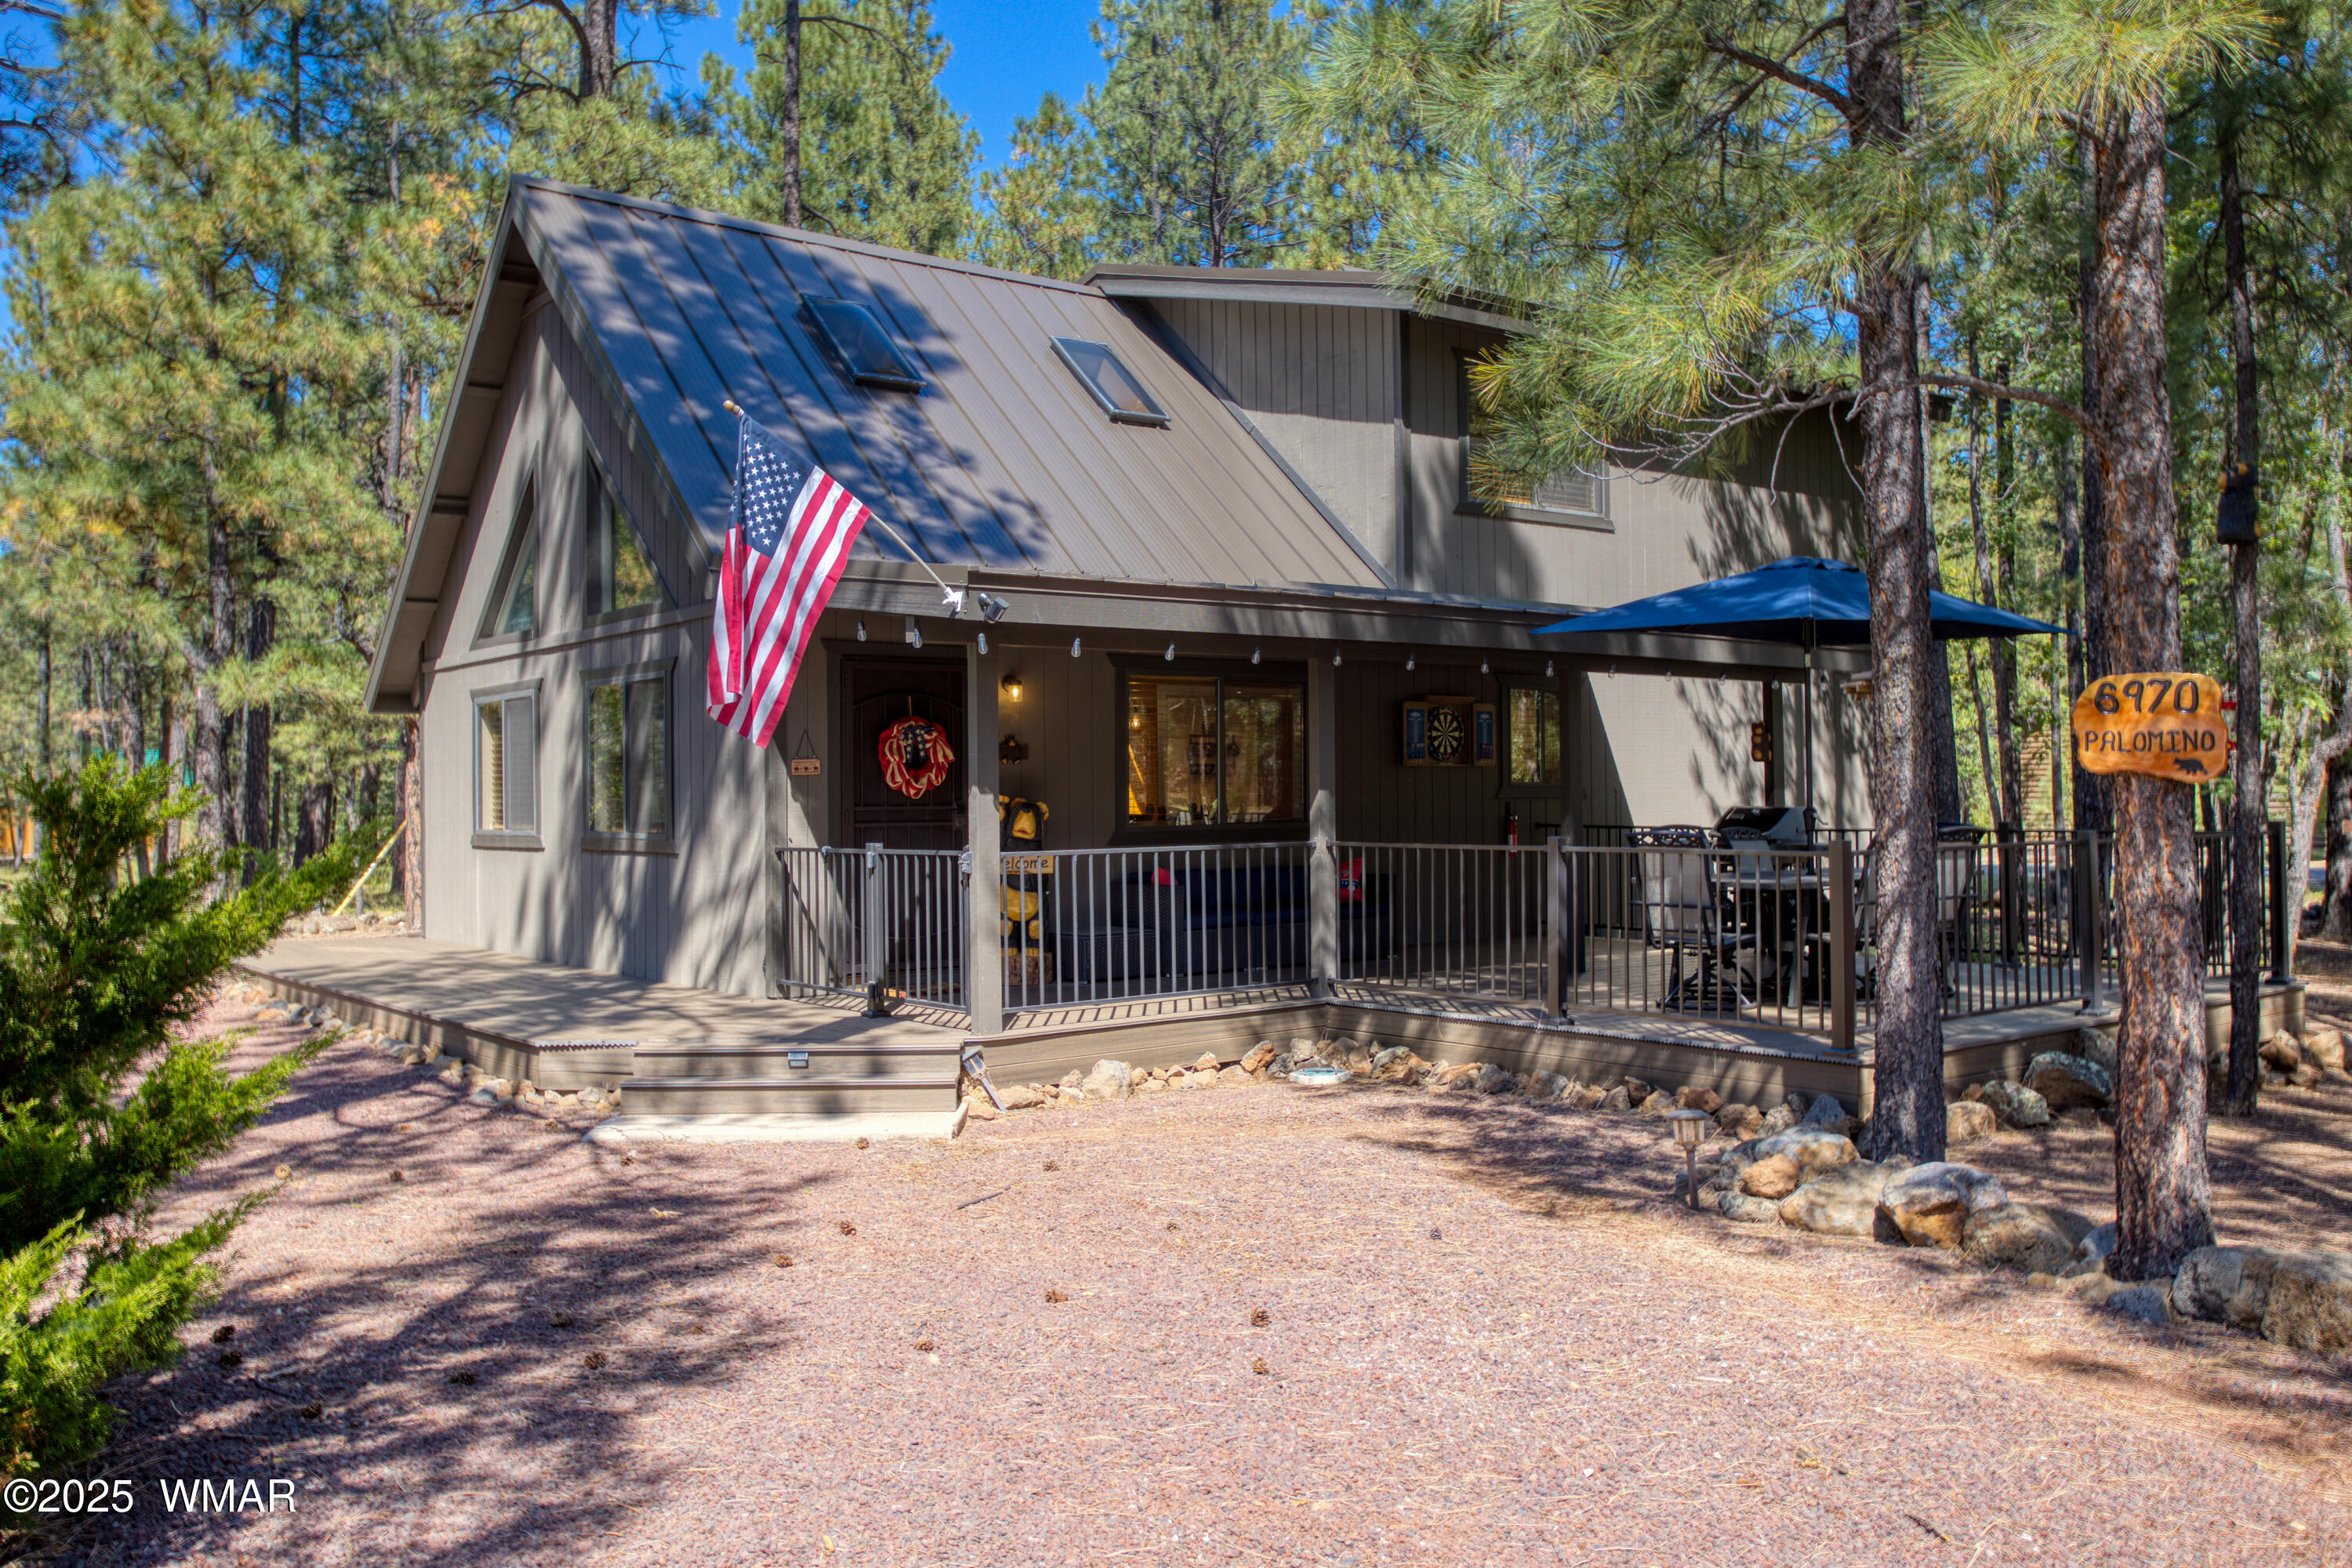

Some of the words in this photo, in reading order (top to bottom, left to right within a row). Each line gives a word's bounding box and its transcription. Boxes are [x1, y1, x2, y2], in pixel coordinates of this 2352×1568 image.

[2094, 677, 2199, 715] 6970
[2084, 728, 2216, 753] PALOMINO
[1000, 856, 1049, 869] elcome
